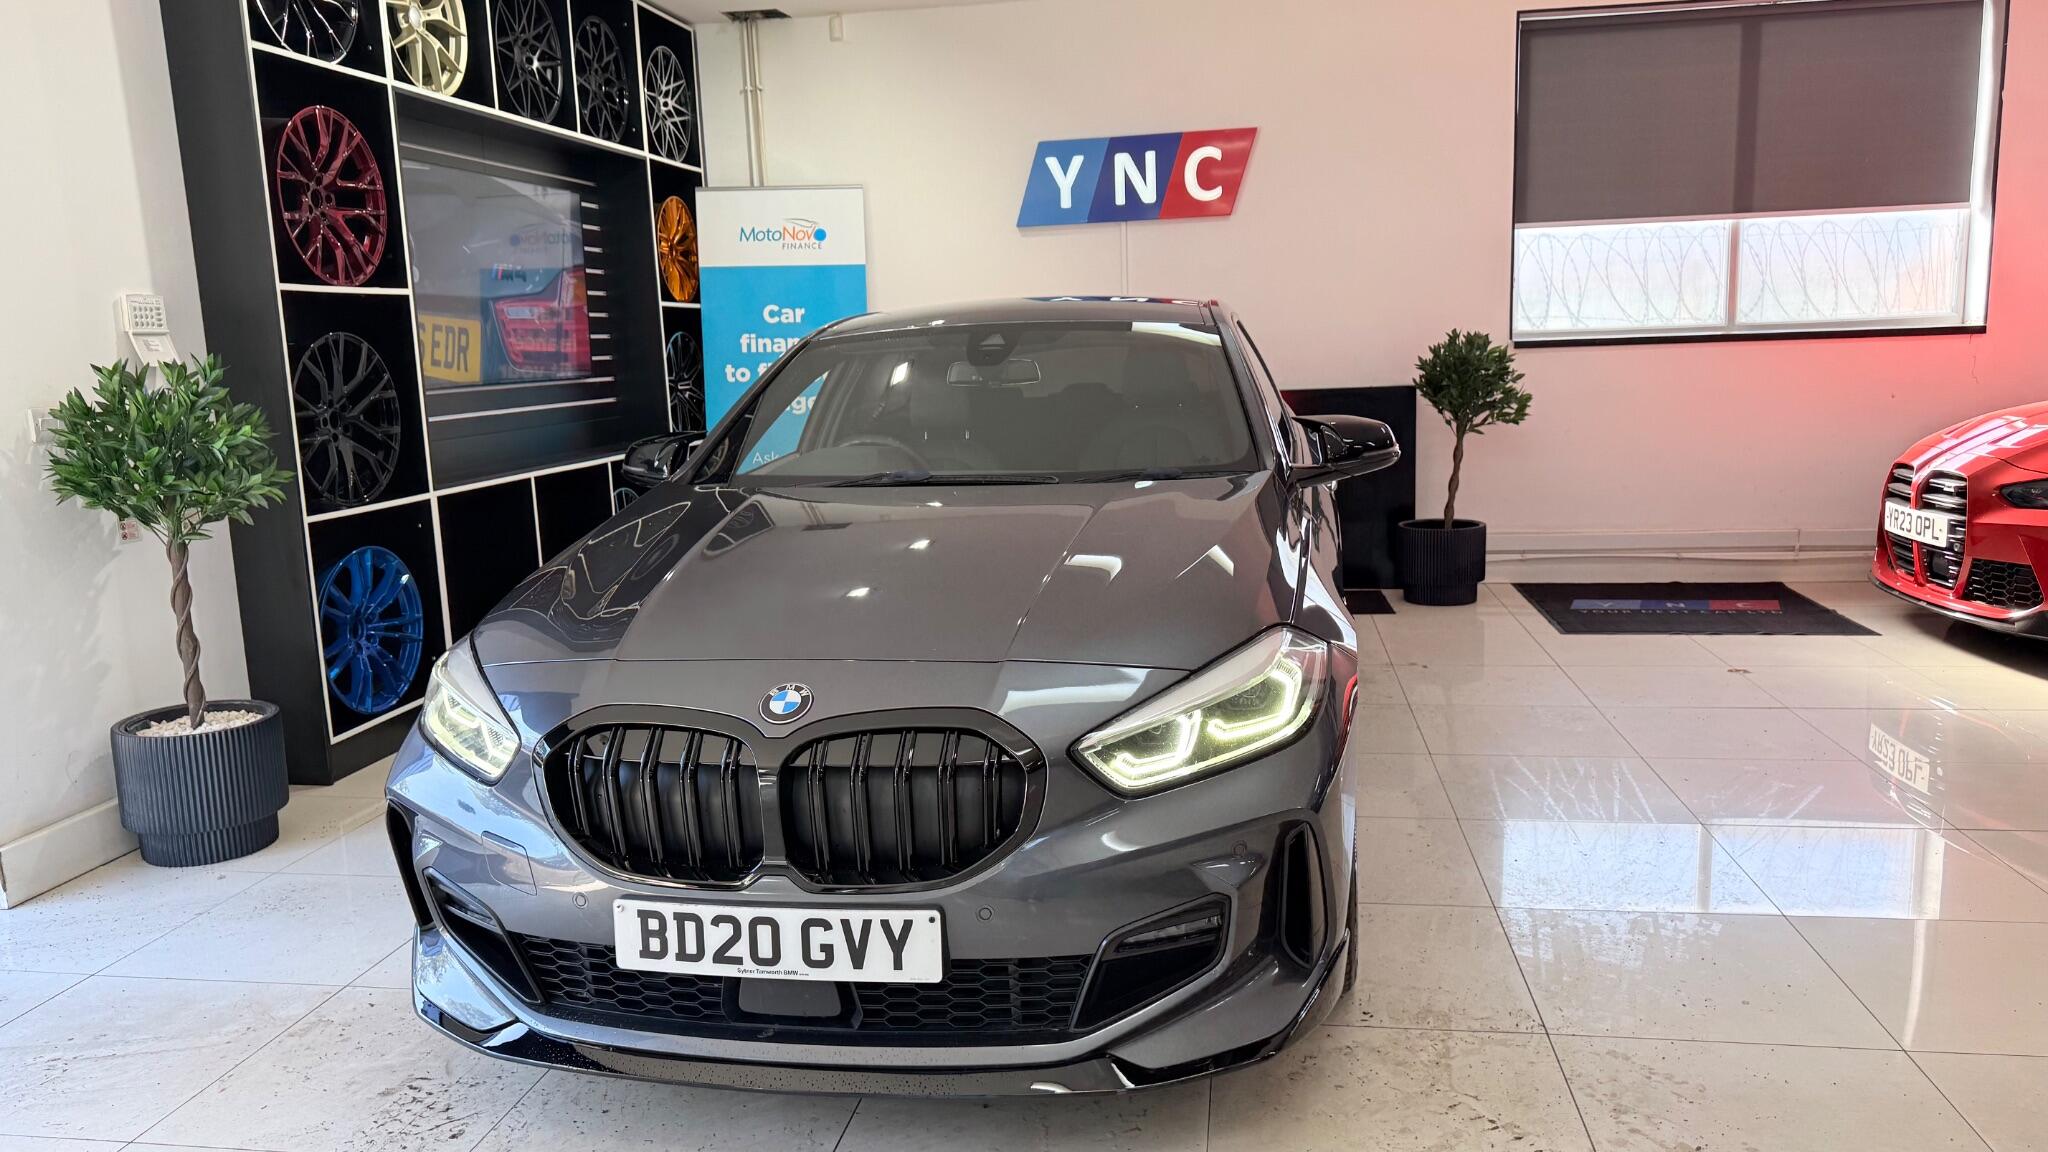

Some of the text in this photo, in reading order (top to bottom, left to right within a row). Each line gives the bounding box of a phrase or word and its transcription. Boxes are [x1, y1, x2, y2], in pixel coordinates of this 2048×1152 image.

[1044, 146, 1222, 208] YNC
[782, 242, 823, 250] FINANCE
[763, 304, 806, 324] Car
[431, 323, 470, 373] EDR
[740, 333, 800, 353] finan
[725, 364, 751, 383] to
[1888, 505, 1939, 541] YR23 OPL
[769, 684, 810, 697] BMW
[637, 909, 914, 971] BD20 GVY
